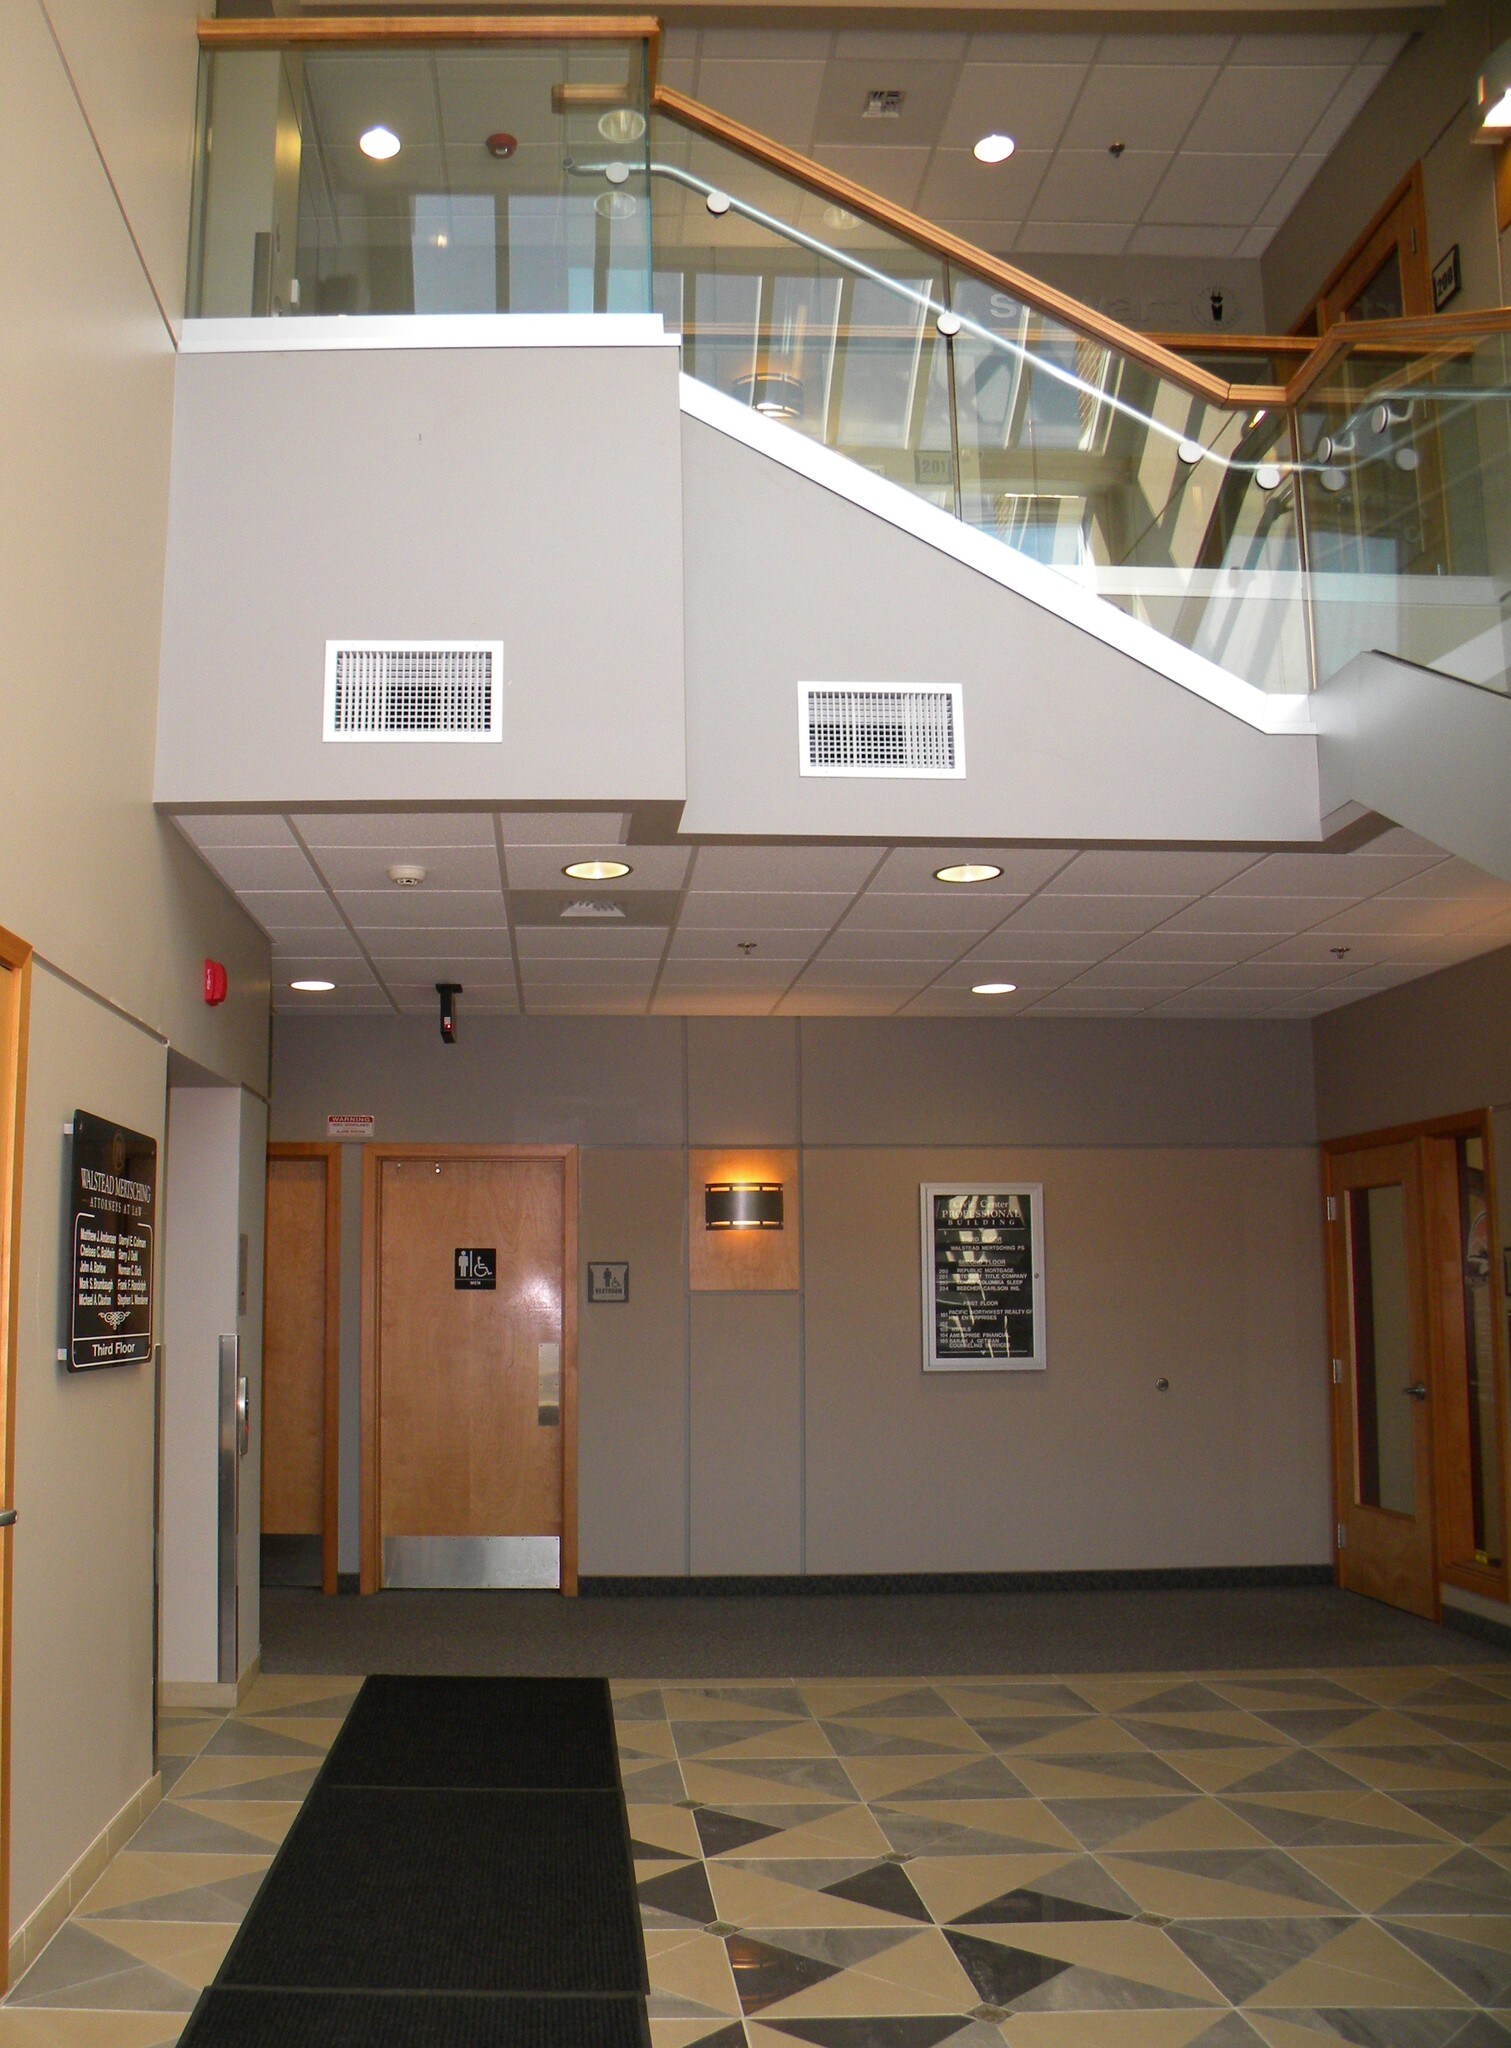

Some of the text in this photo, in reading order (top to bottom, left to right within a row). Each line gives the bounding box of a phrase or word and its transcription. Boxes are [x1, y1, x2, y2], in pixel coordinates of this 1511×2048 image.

[1437, 266, 1453, 297] 200
[921, 460, 946, 473] 201
[80, 1167, 151, 1203] WALSTEAD MERTSCHING
[90, 1196, 142, 1217] ATTORNEYS AT LAW
[980, 1199, 1009, 1208] Center
[941, 1209, 1021, 1218] PROFESSIONAL
[92, 1341, 135, 1357] Third Floor
